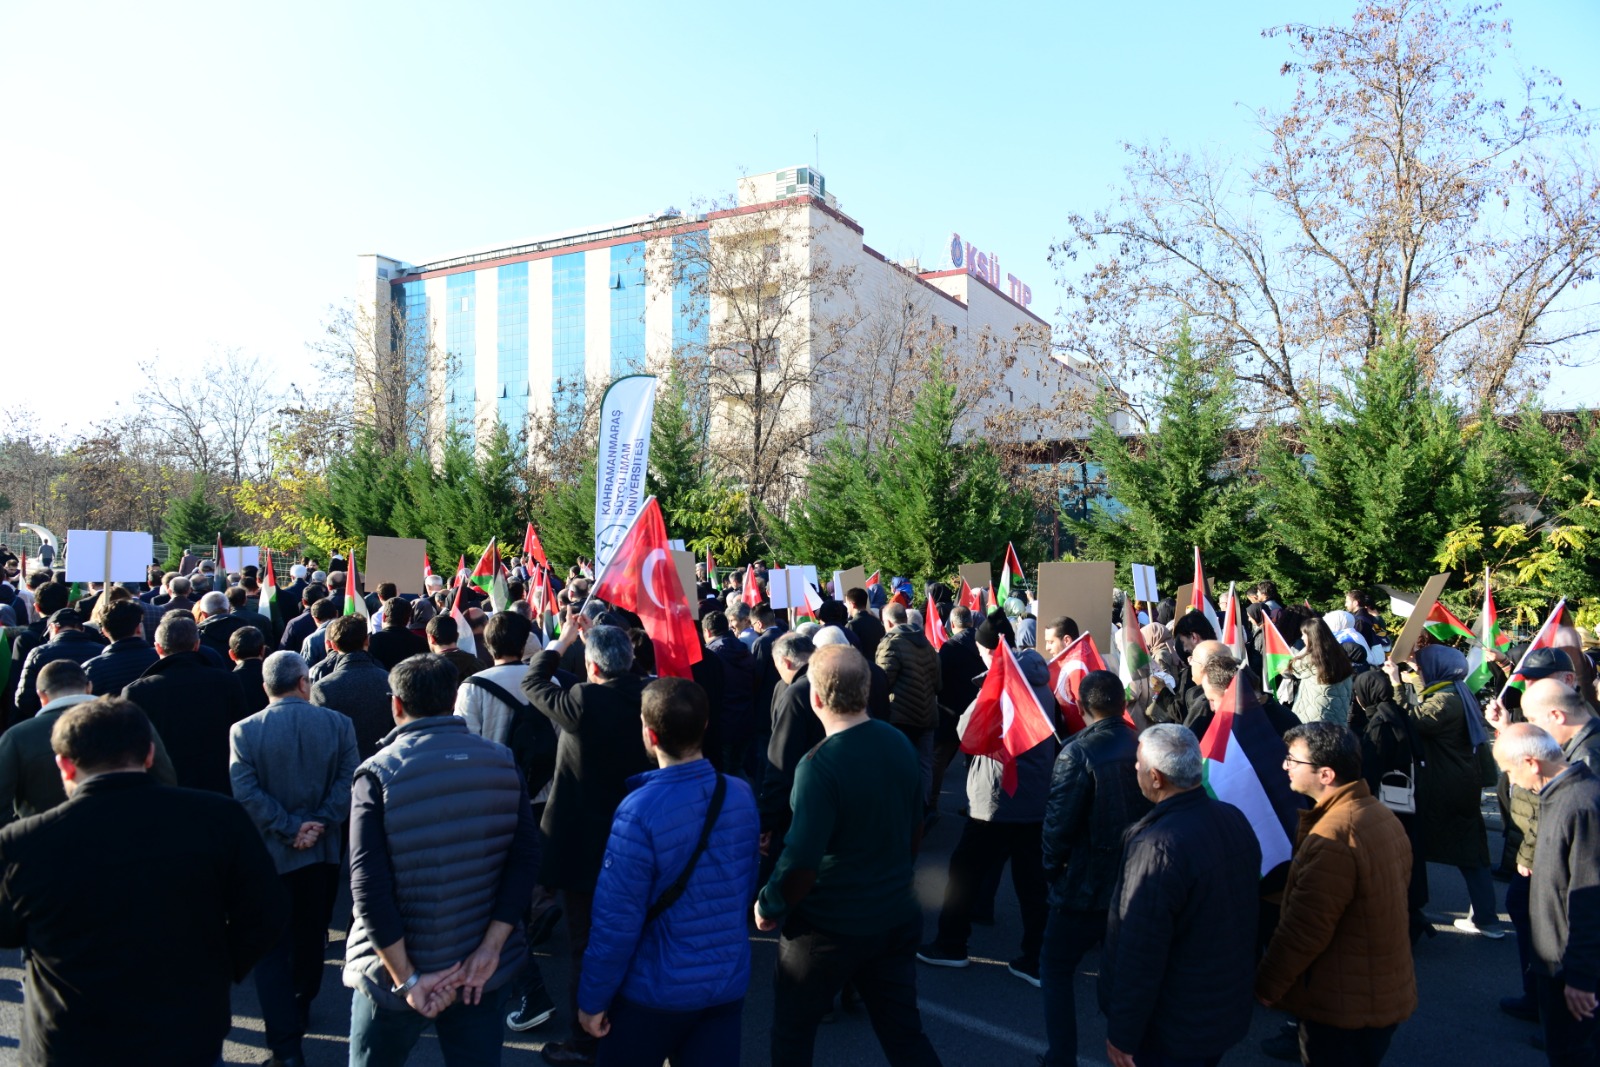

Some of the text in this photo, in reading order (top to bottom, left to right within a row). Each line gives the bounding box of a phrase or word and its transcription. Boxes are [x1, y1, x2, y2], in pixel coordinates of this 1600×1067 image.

[966, 241, 1032, 308] KSÜ TIP
[602, 409, 623, 515] KAHRAMANMARAŞ
[614, 477, 628, 515] SÜTÇÜ
[625, 438, 644, 515] ÜNİVERSİTESİ
